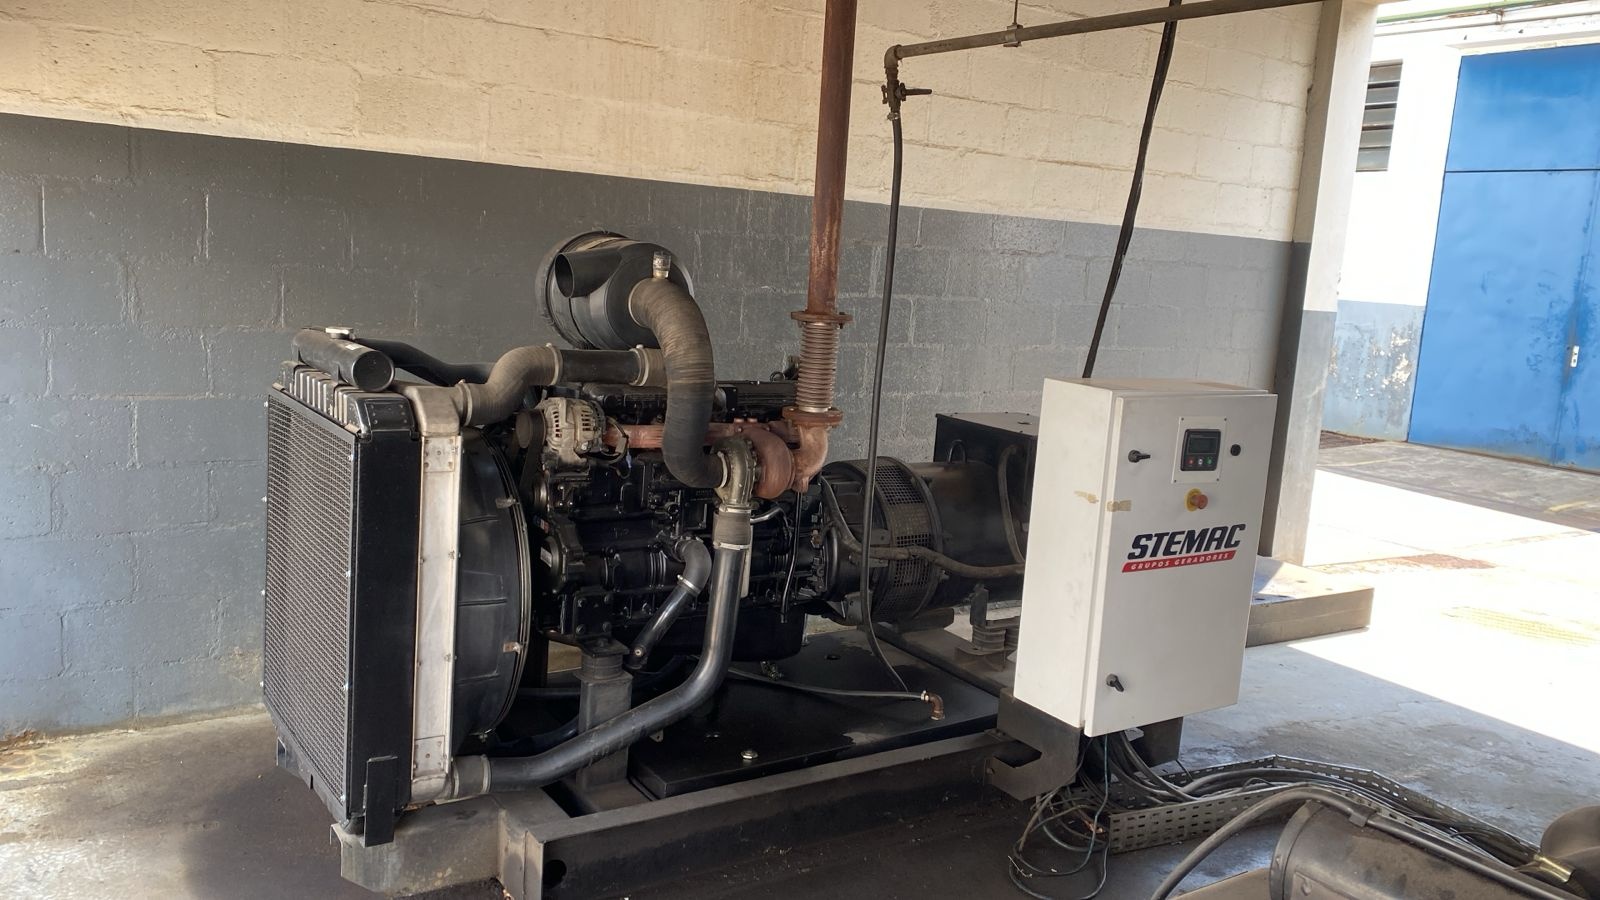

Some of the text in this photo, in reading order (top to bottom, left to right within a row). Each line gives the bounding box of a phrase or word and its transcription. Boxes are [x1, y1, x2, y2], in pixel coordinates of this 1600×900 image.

[1127, 523, 1246, 560] STEMAC
[1131, 552, 1229, 570] GRUPOS GERADORES
